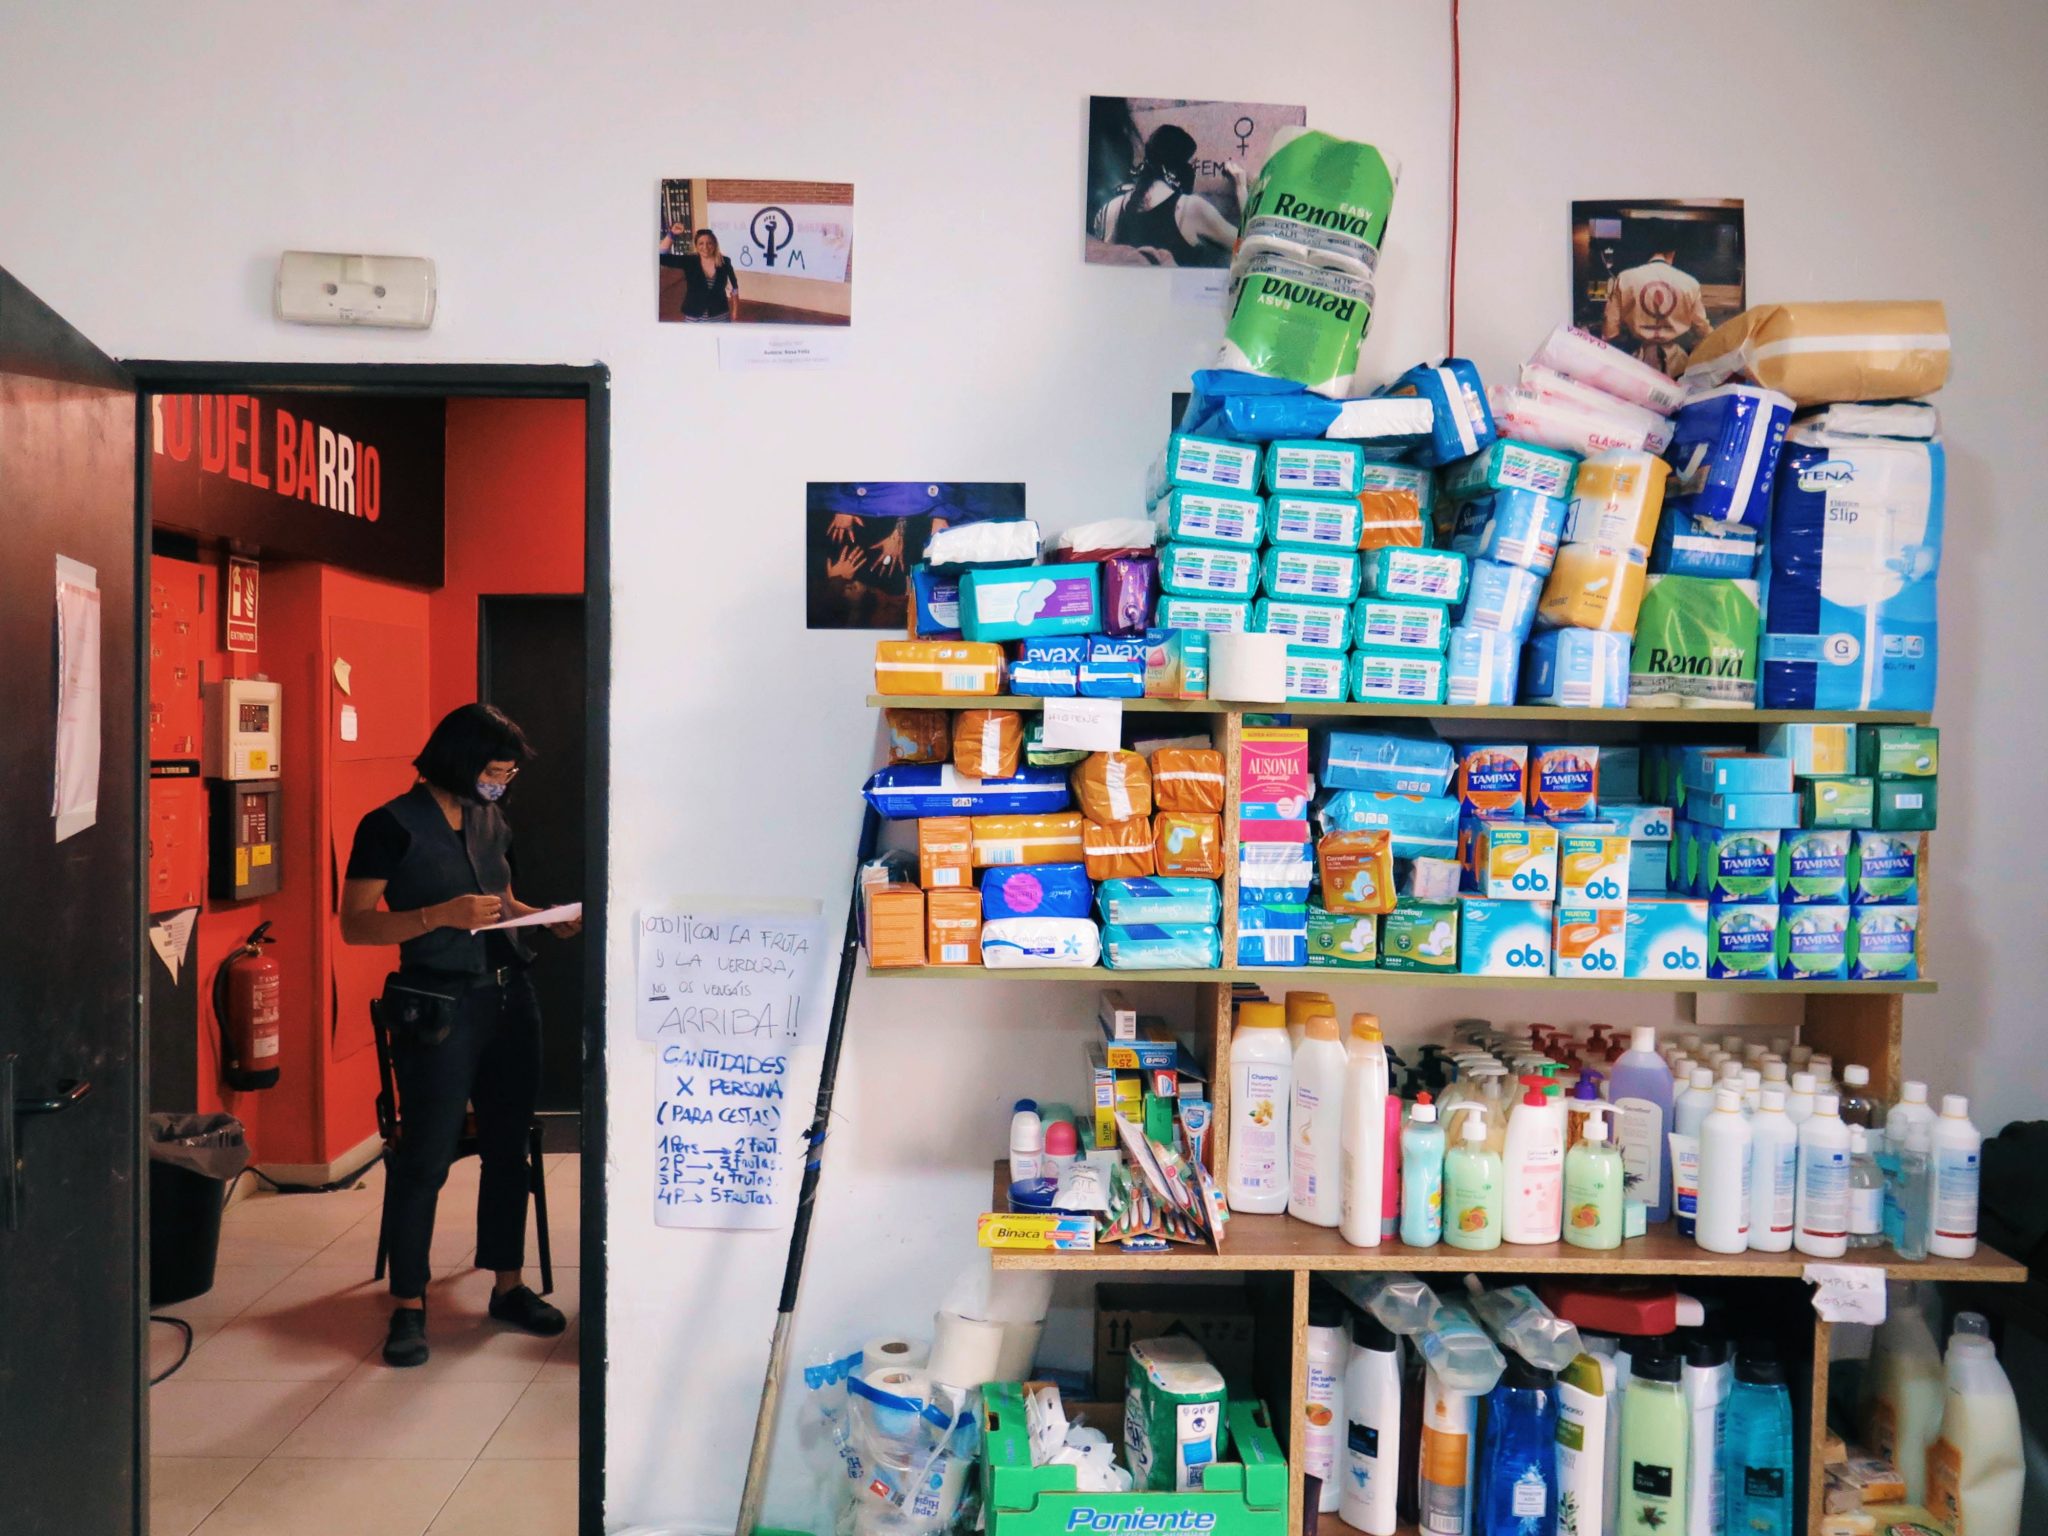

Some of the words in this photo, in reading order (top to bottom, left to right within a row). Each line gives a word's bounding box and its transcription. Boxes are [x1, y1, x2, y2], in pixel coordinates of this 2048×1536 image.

[1274, 193, 1368, 237] Renova
[1340, 202, 1372, 218] EASY
[740, 245, 752, 267] 8
[788, 249, 805, 270] M
[1258, 295, 1291, 310] EASY
[1262, 277, 1357, 322] Renova
[201, 395, 270, 489] DEL
[277, 409, 381, 522] BARRIO
[1803, 471, 1854, 481] TENA
[1829, 508, 1859, 524] Slip
[1027, 646, 1080, 663] evax
[1094, 644, 1146, 658] evax
[1834, 640, 1849, 654] G
[1649, 649, 1743, 677] Renova
[1248, 758, 1300, 775] AUSONIA
[1471, 773, 1517, 785] TAMPAX
[1544, 773, 1588, 786] TAMPAX
[1722, 857, 1770, 870] TAMPAX
[1793, 857, 1841, 871] TAMPAX
[1864, 857, 1910, 871] TAMPAX
[1512, 868, 1550, 891] o.b.
[1585, 876, 1622, 899] o.b.
[729, 925, 750, 944] LA
[760, 931, 810, 956] FRUTA
[1722, 933, 1770, 946] TAMPAX
[1793, 933, 1840, 946] TAMPAX
[1863, 933, 1910, 946] TAMPAX
[675, 954, 702, 967] LA
[1506, 943, 1545, 967] o.b.
[1581, 947, 1618, 970] o.b.
[1663, 946, 1701, 970] o.b.
[679, 981, 694, 994] OS
[663, 1046, 786, 1075] CANTIDADES
[1112, 1059, 1132, 1068] 25%
[676, 1076, 694, 1096] X
[709, 1078, 783, 1099] PERSONA
[735, 1138, 745, 1153] 2
[660, 1157, 669, 1171] 2
[713, 1172, 725, 1184] 4
[658, 1188, 672, 1205] 4
[711, 1187, 722, 1203] 5
[997, 1228, 1040, 1239] Binaca
[1066, 1506, 1217, 1532] Poniente
